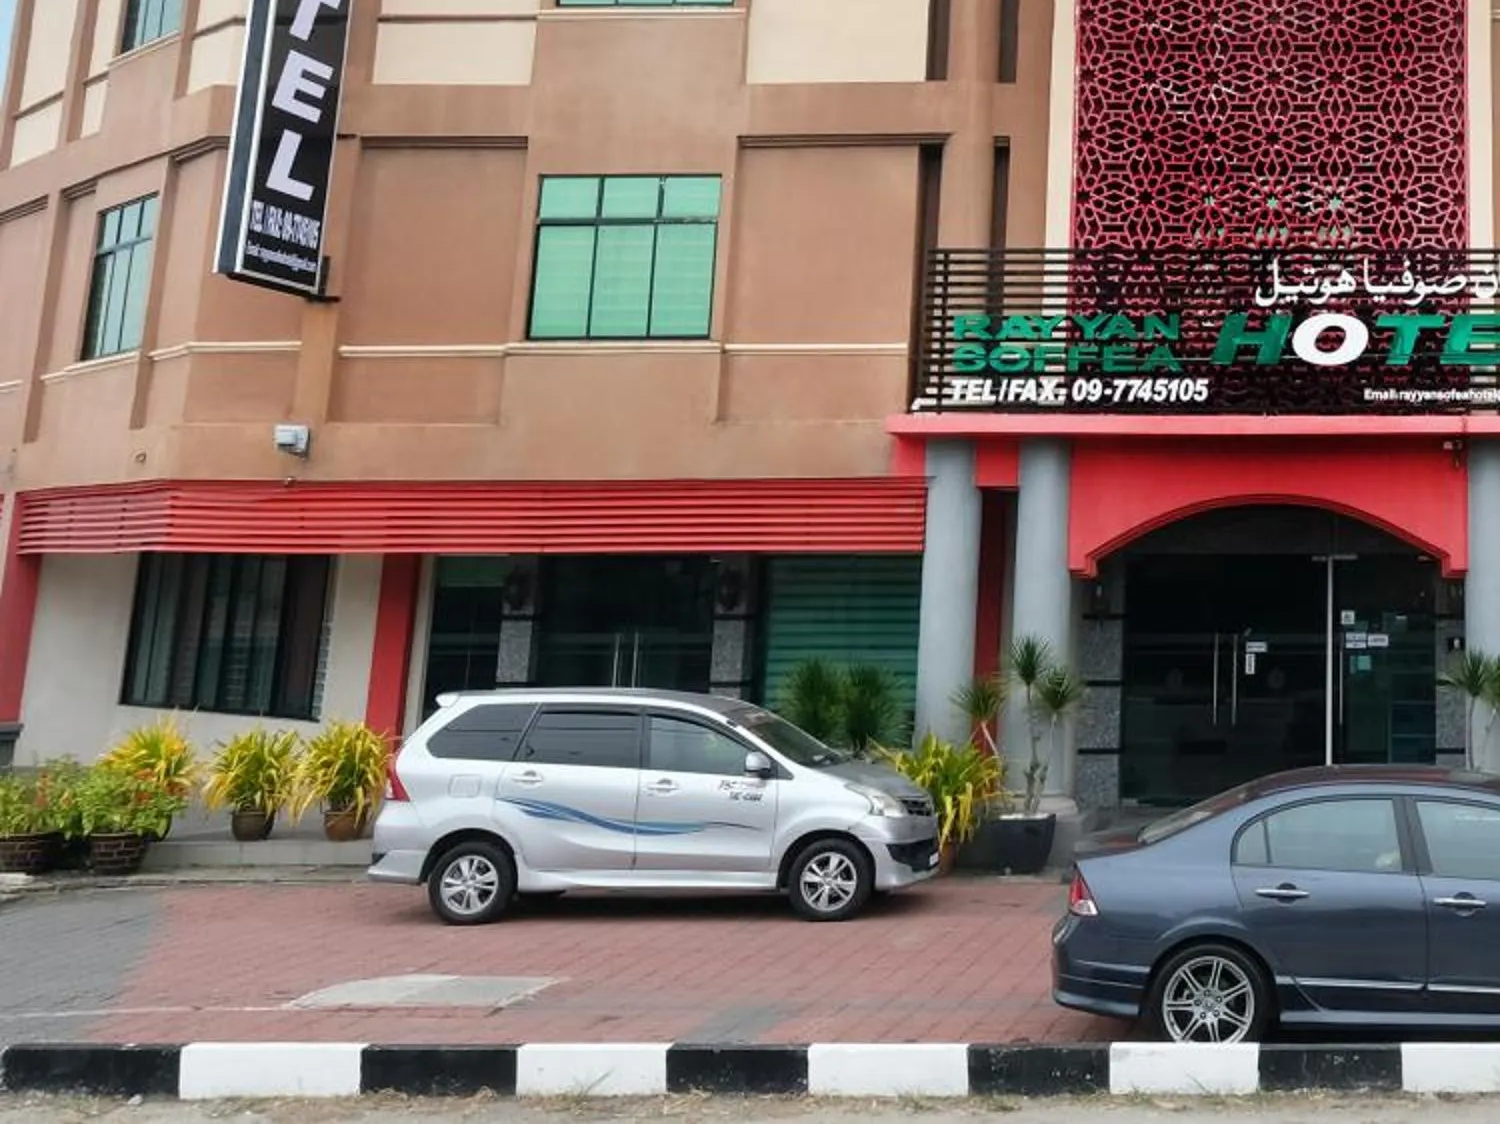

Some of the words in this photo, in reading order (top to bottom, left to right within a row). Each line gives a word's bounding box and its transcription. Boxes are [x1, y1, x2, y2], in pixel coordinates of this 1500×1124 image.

[1254, 257, 1357, 307] هوتيل
[1363, 257, 1468, 305] صوفيا
[952, 313, 1180, 341] RAYYAN
[951, 343, 1183, 373] SOFFEA
[1071, 378, 1209, 403] 09-7745105
